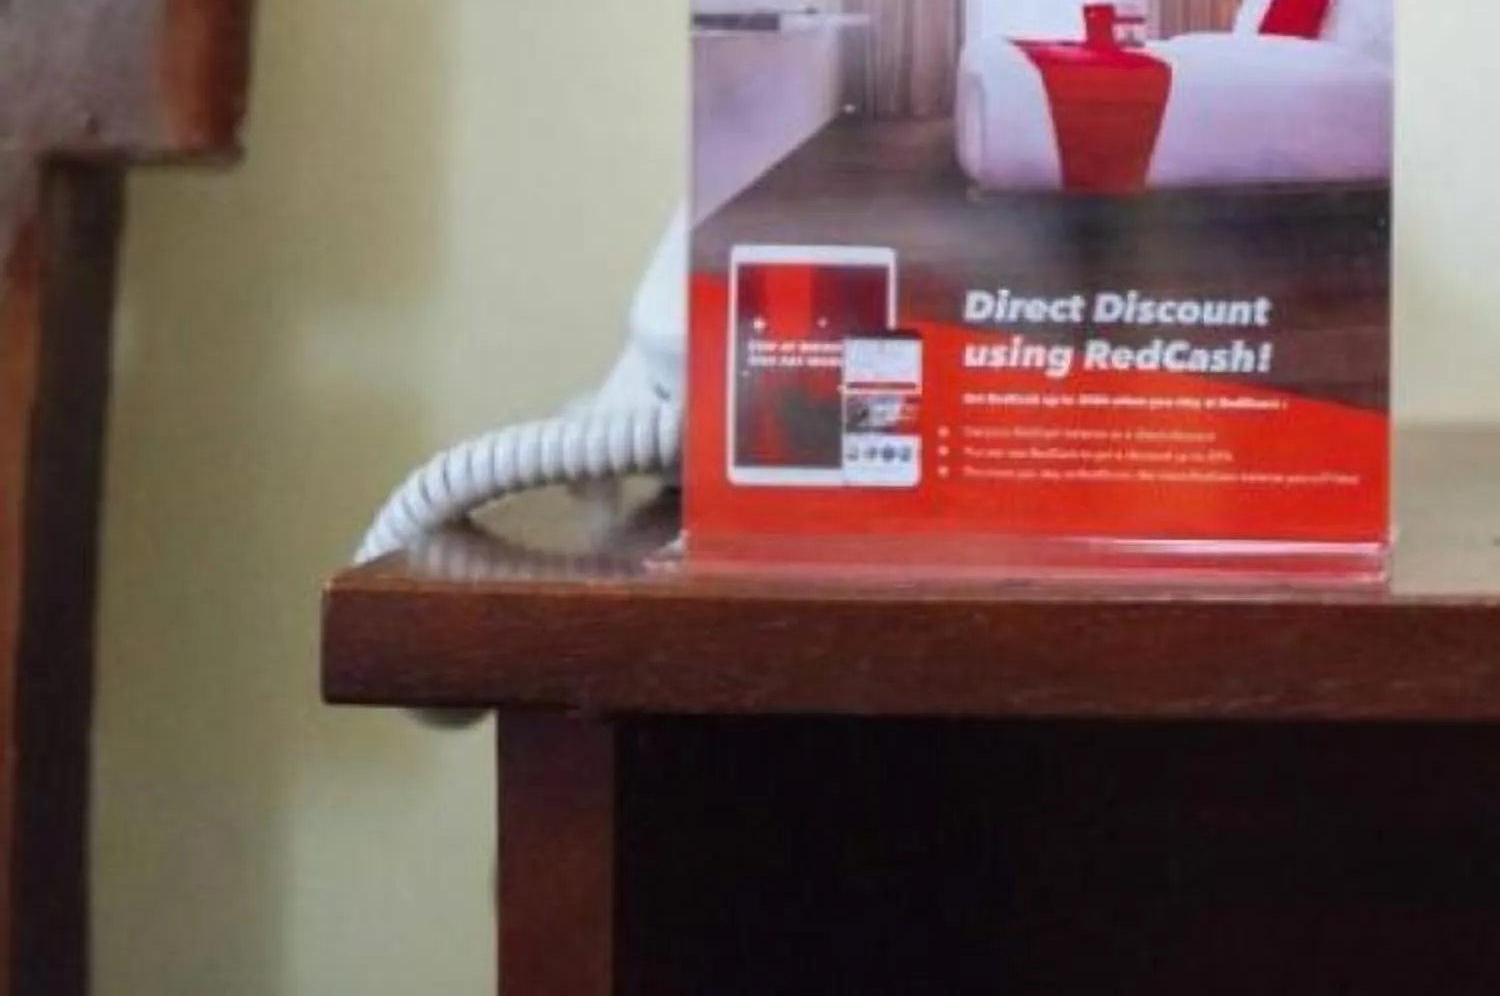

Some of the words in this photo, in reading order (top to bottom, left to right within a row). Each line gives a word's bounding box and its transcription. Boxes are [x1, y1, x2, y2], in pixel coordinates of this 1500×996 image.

[963, 288, 1084, 324] Direct
[1092, 289, 1273, 326] Discount
[963, 335, 1075, 378] using
[1081, 336, 1273, 374] RedCash!
